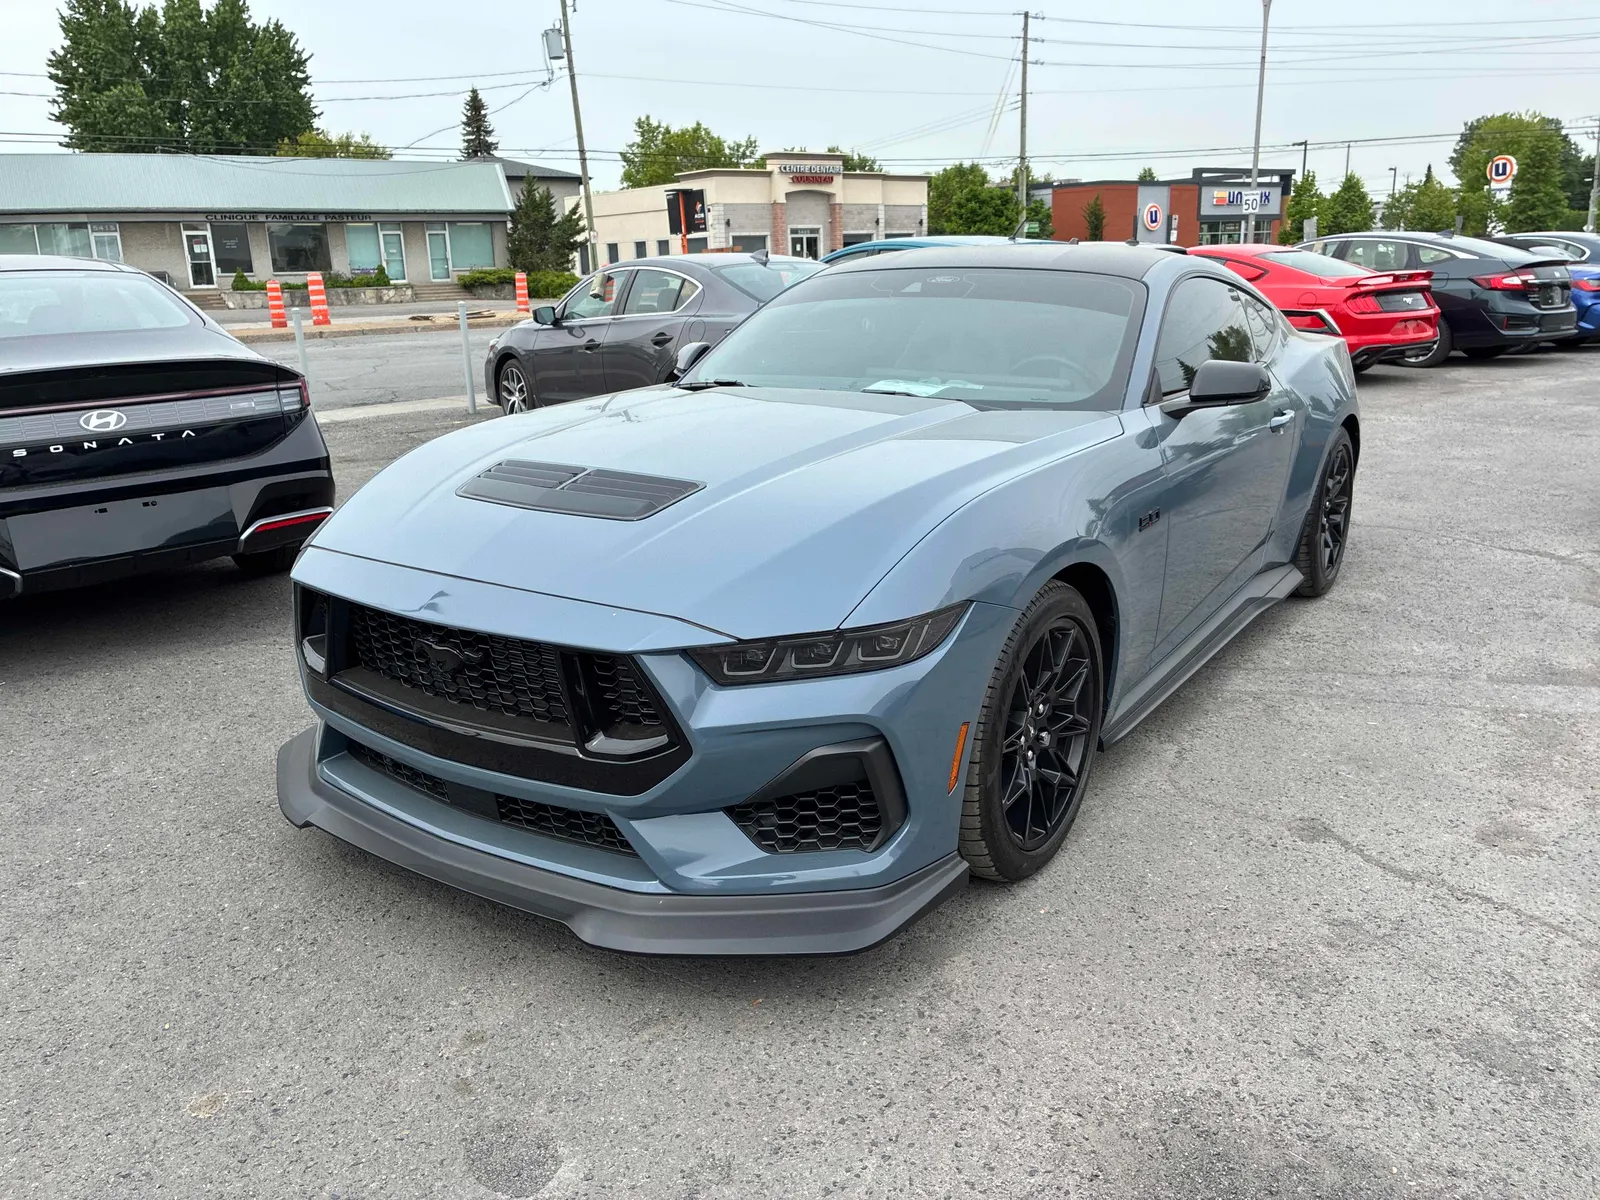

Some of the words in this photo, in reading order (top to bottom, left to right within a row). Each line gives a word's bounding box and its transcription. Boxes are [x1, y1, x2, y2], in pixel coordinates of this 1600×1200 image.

[811, 165, 843, 173] DENTAIRE
[1244, 198, 1258, 211] 50
[12, 429, 195, 458] SONATA
